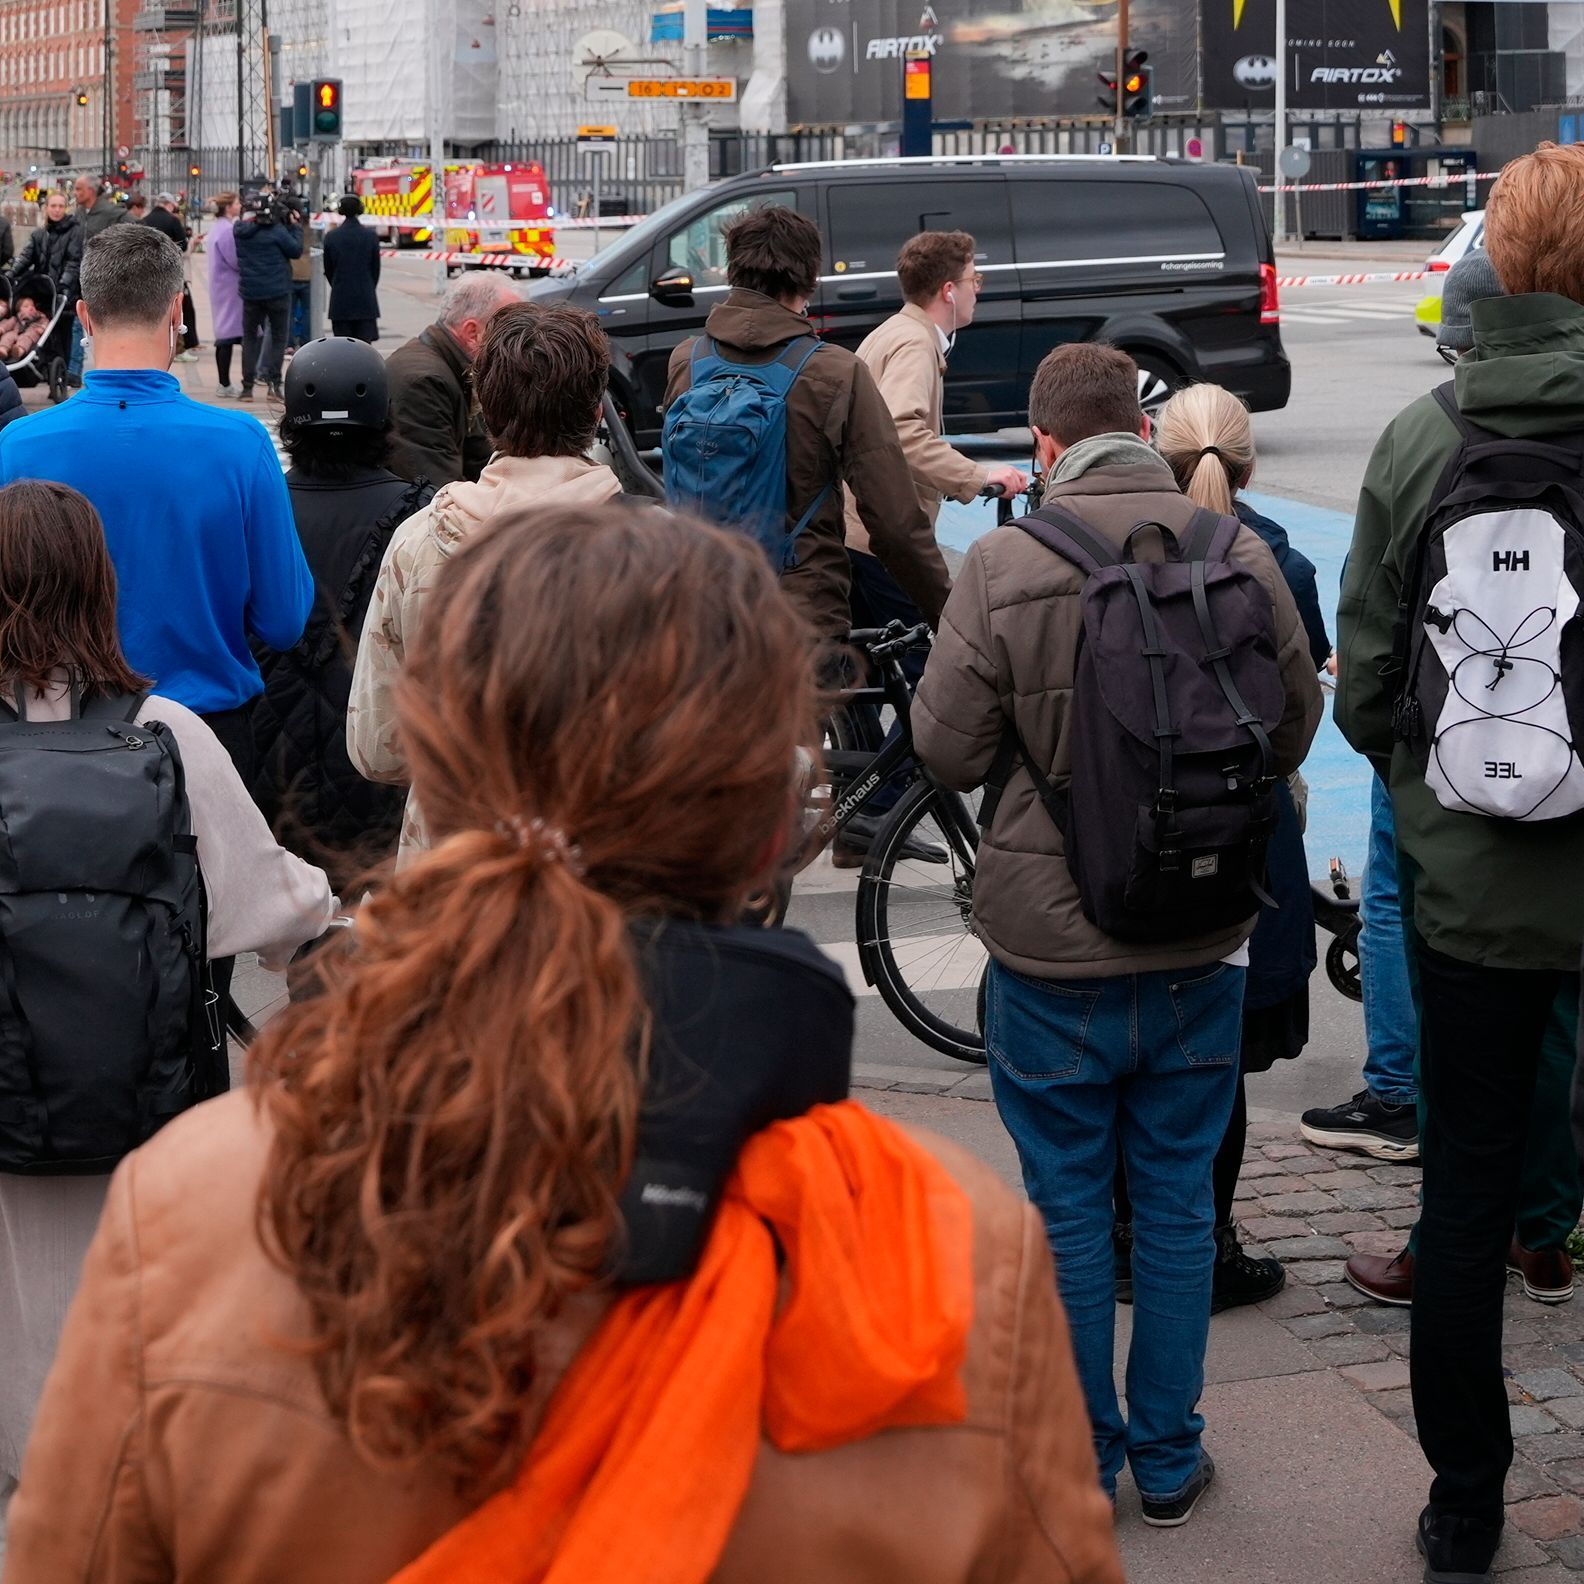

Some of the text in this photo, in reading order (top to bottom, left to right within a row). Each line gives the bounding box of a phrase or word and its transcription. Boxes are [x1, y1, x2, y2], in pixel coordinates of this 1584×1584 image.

[866, 34, 938, 60] AIRTOX
[1285, 38, 1355, 48] OMING SOON
[1310, 67, 1397, 83] AIRTOX
[638, 84, 652, 94] 16
[1160, 261, 1224, 271] #changeiscoming
[1493, 550, 1530, 572] HH
[1484, 761, 1522, 778] 33L
